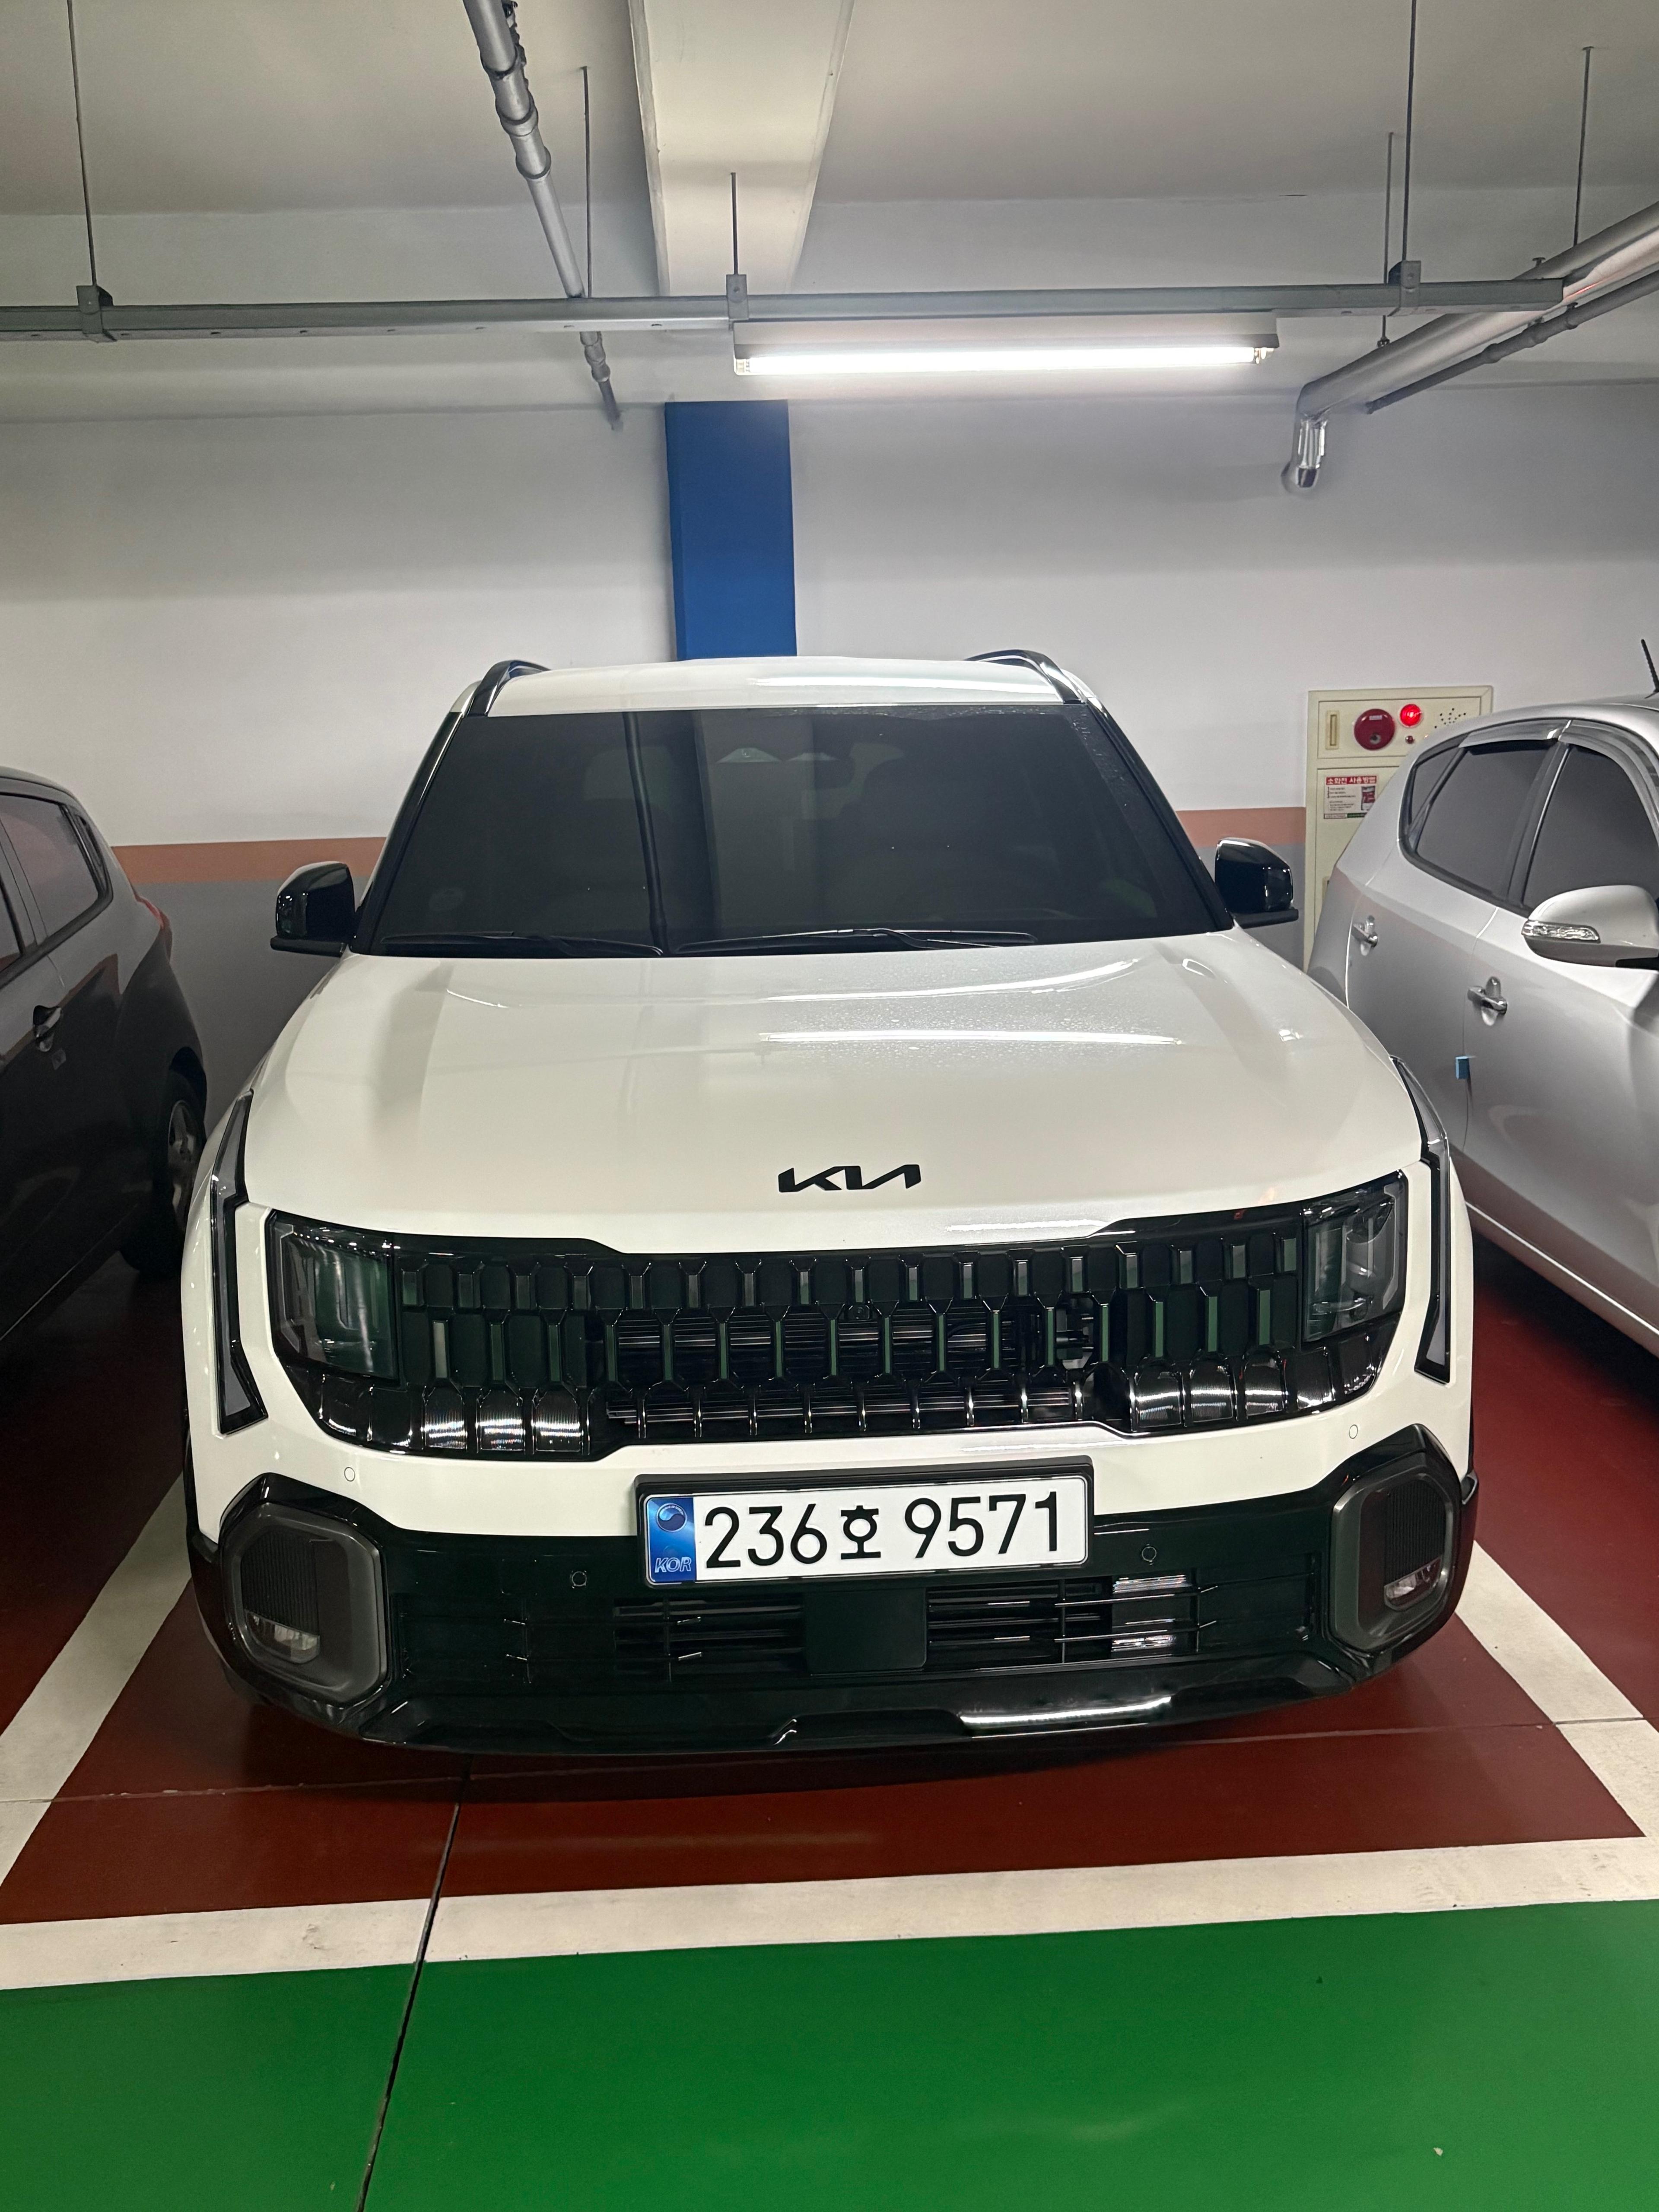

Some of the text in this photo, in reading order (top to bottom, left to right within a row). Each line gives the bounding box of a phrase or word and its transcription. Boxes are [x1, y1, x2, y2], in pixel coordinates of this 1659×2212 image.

[778, 1164, 922, 1193] KIA
[705, 1491, 1057, 1569] 236호 9571
[655, 1557, 692, 1573] KOR
